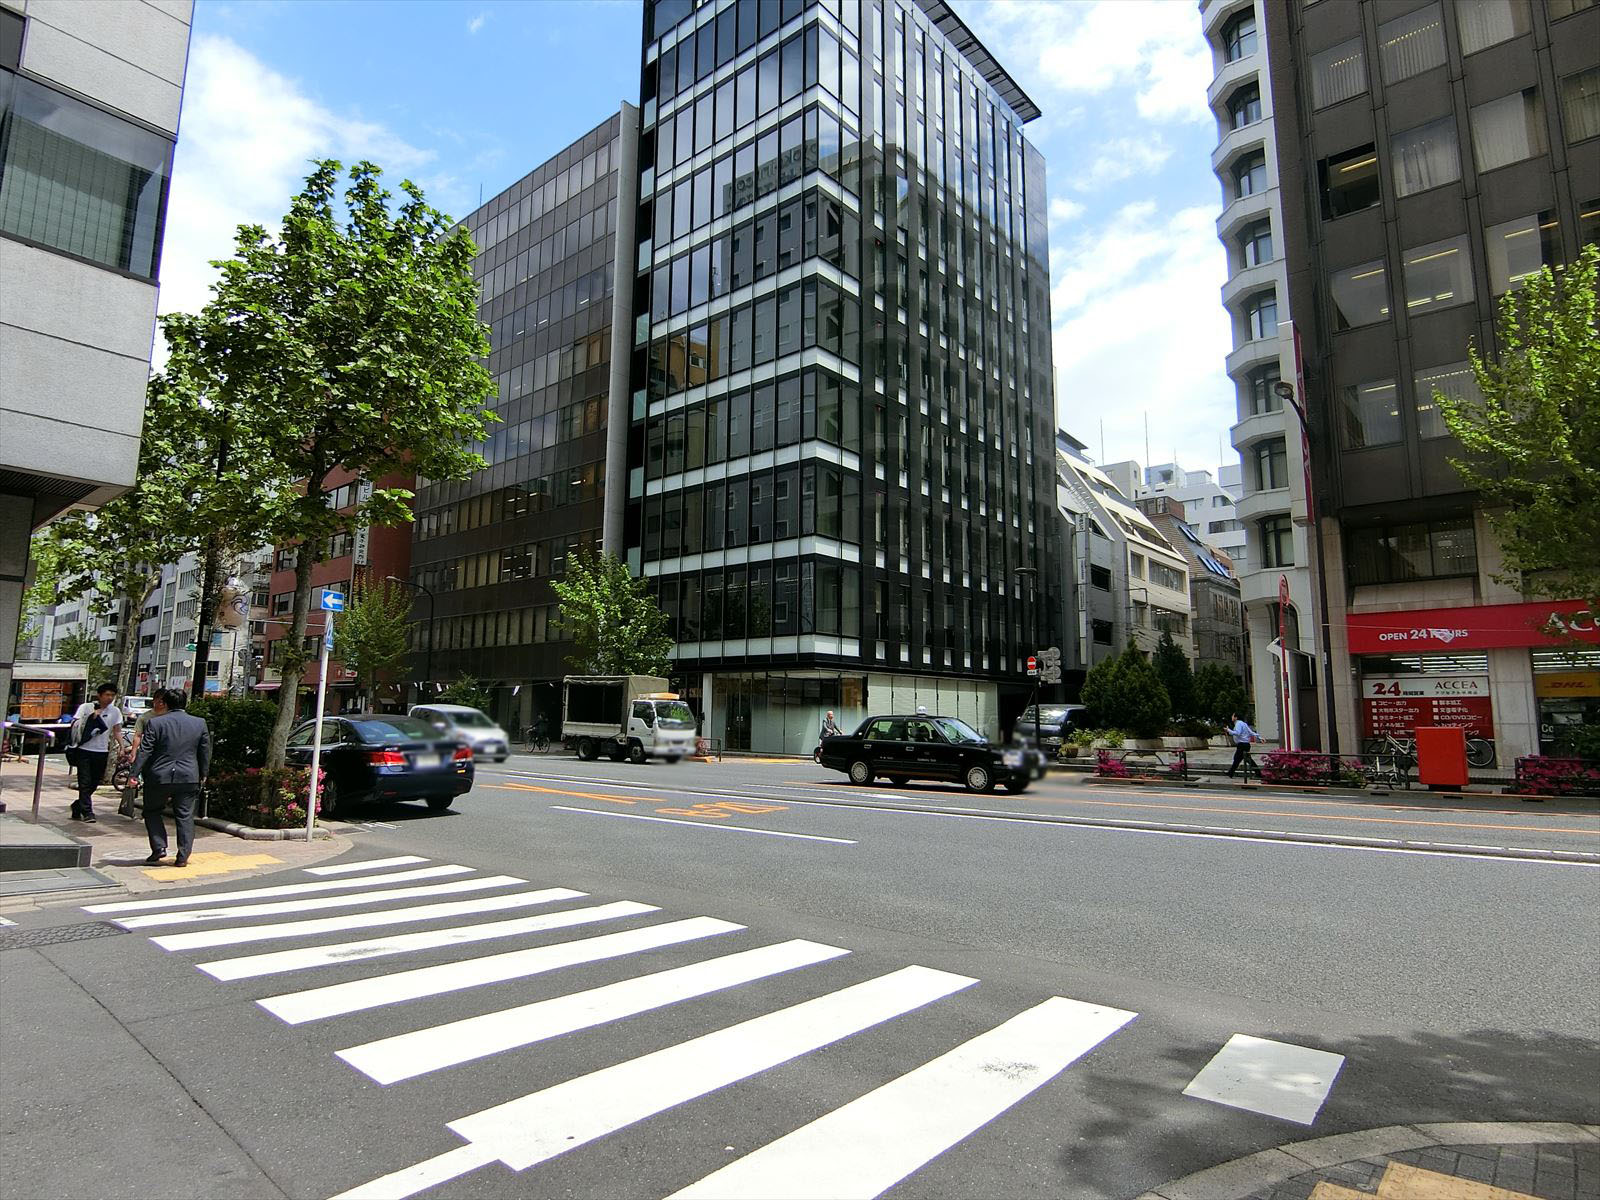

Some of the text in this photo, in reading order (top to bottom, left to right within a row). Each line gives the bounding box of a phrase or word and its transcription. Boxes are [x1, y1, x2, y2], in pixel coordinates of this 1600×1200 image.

[1544, 610, 1600, 634] AC
[1378, 632, 1408, 641] OPEN
[1410, 628, 1428, 640] 24
[1373, 682, 1402, 697] 24
[1435, 681, 1478, 690] ACCEA
